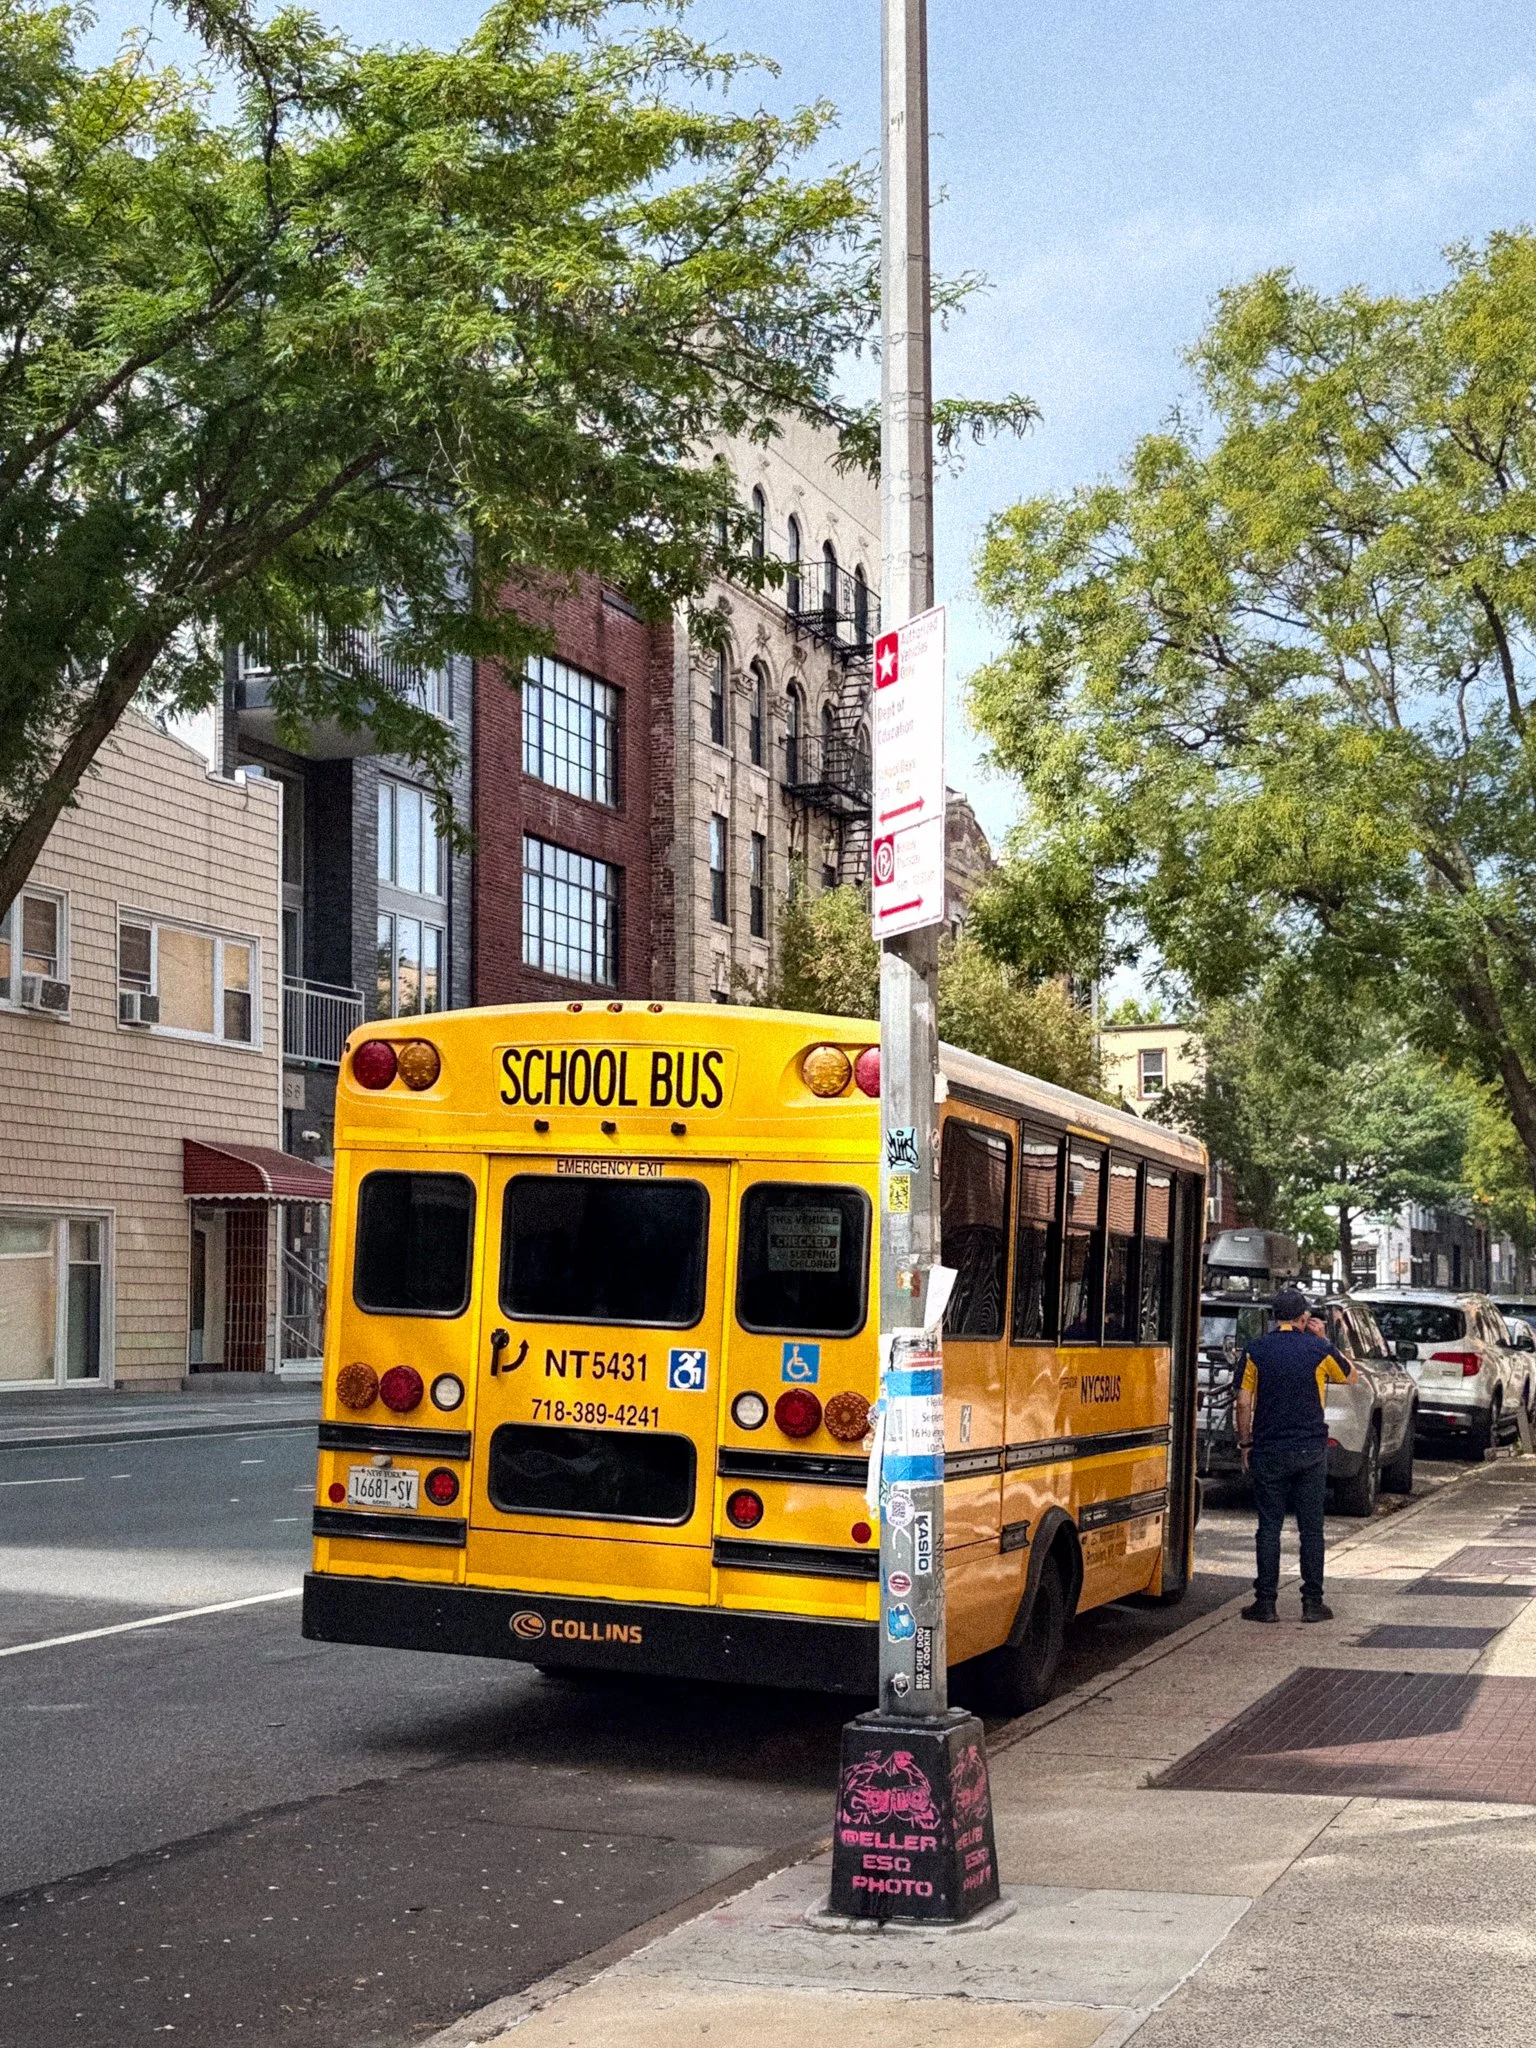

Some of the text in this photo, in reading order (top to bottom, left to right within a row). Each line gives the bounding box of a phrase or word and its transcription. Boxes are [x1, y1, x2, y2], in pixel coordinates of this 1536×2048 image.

[500, 1048, 724, 1109] SCHOOL BUS
[556, 1158, 665, 1178] EMERGENCY EXIT
[795, 1215, 839, 1225] VEHICLE
[775, 1236, 832, 1248] CHECKED
[789, 1249, 837, 1260] SLEEPING
[789, 1259, 837, 1269] CHILDREN
[1080, 1375, 1121, 1404] NYCSBUS
[531, 1398, 659, 1428] 718-389-4241
[551, 1619, 643, 1644] COLLINS
[916, 1650, 924, 1672] CHEF
[923, 1629, 931, 1690] STAY COOKIN
[863, 1854, 911, 1873] ESQ
[852, 1875, 933, 1897] PHOTO
